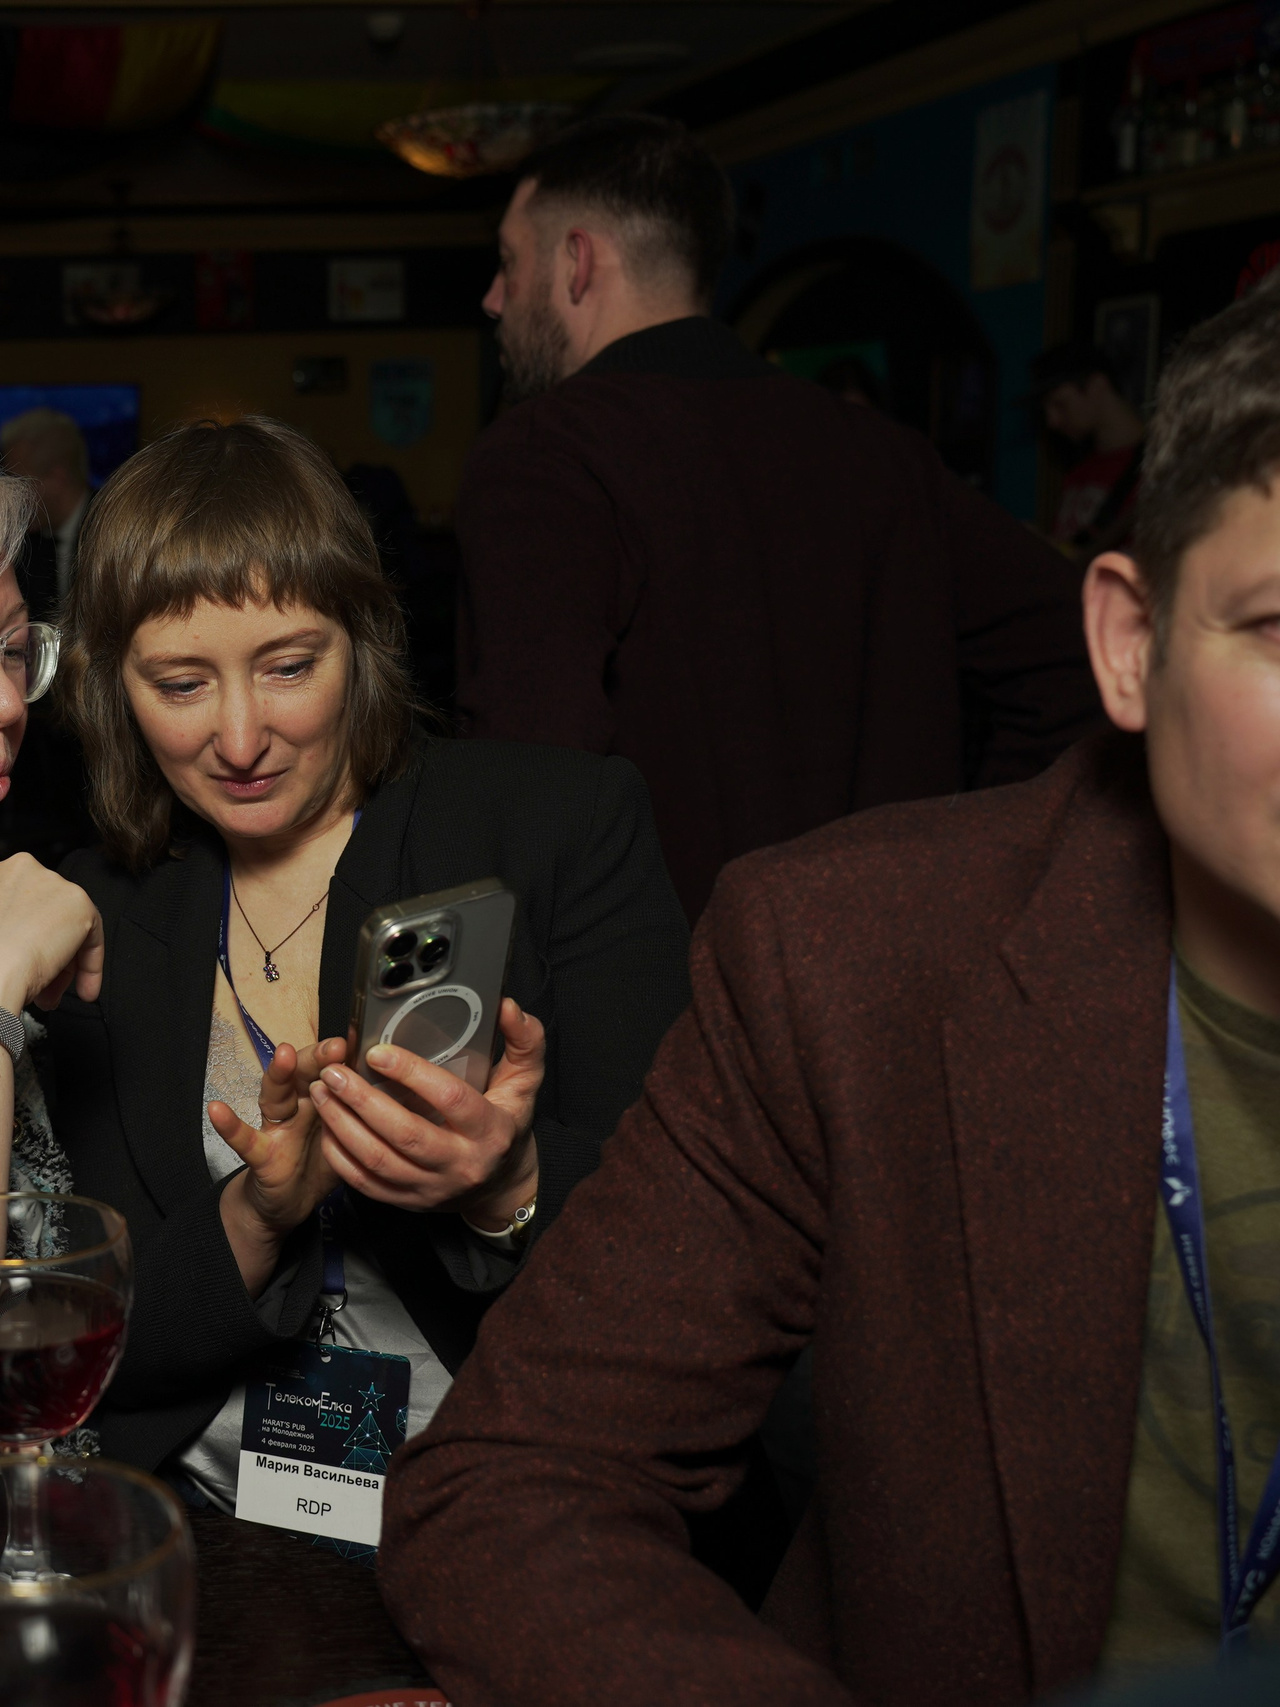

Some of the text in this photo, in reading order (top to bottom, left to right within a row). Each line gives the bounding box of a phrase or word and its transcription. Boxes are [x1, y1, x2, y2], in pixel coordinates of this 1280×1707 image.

[413, 990, 436, 1004] NATIVE
[262, 1417, 306, 1431] HARAT'S PUB
[320, 1412, 351, 1431] 2025
[261, 1425, 315, 1440] на Молодежной
[268, 1438, 297, 1450] февраля
[298, 1443, 316, 1453] 2025
[256, 1455, 380, 1490] Мария Васильева
[296, 1497, 332, 1516] RDP
